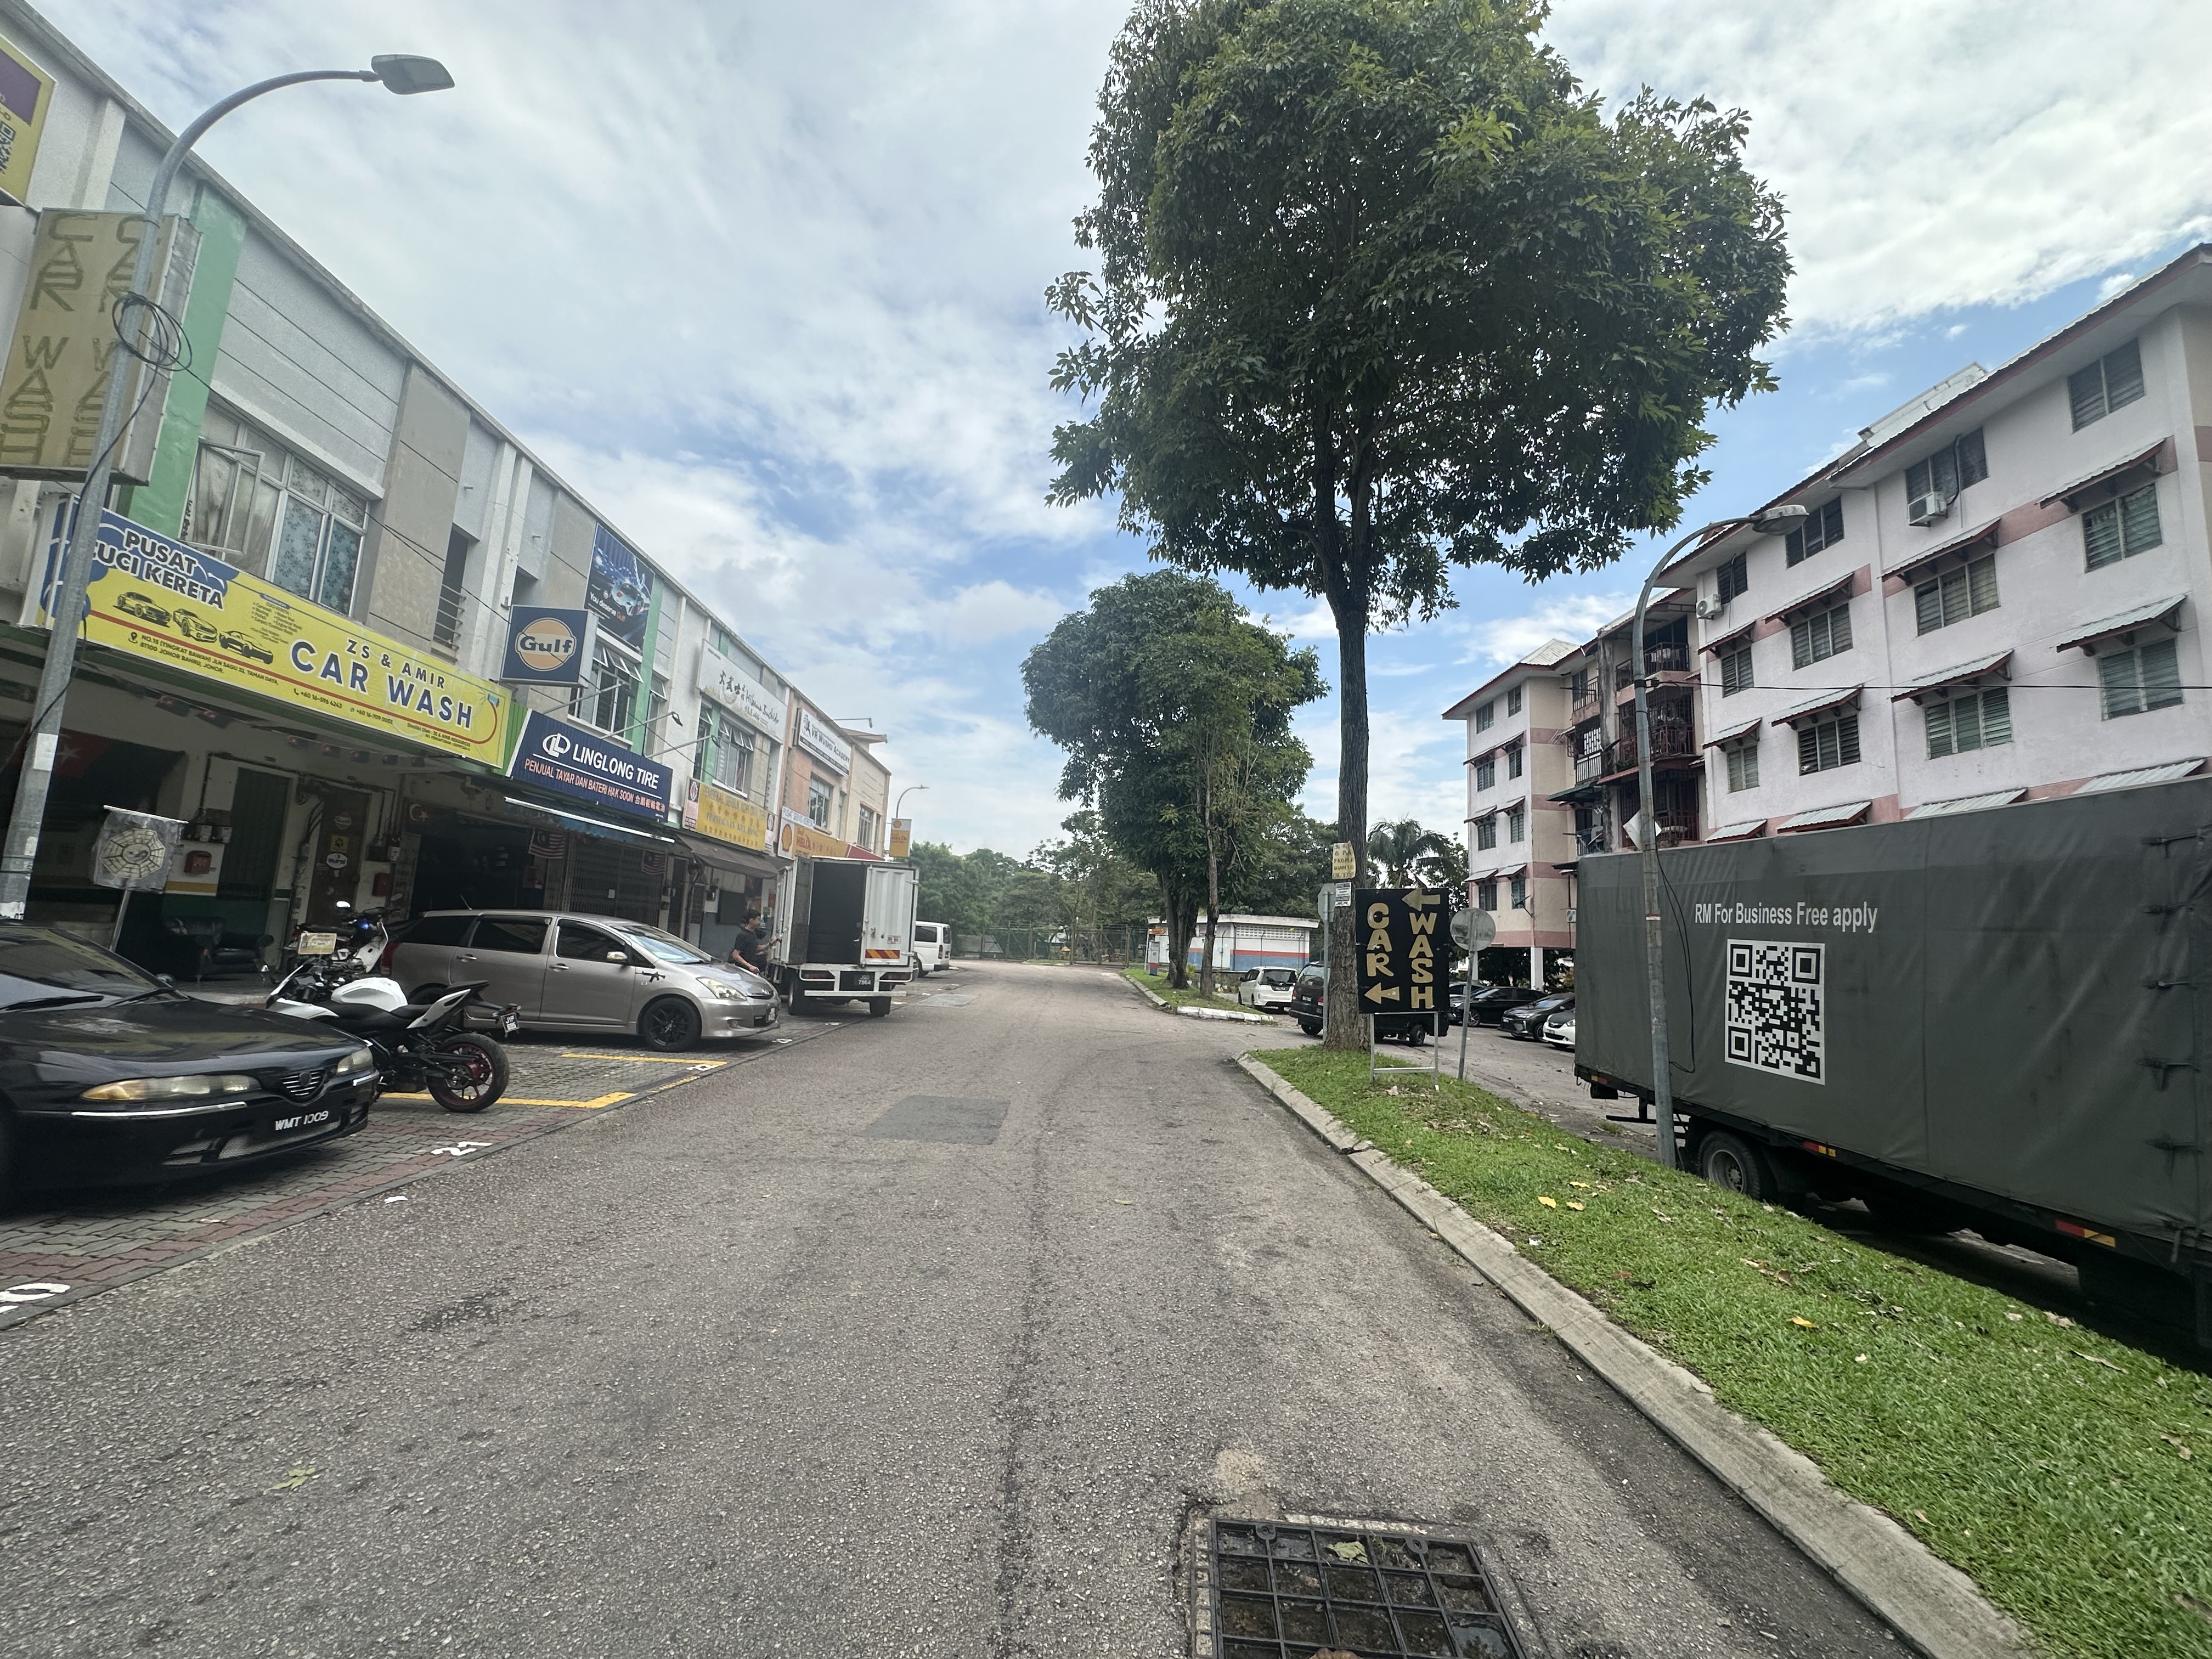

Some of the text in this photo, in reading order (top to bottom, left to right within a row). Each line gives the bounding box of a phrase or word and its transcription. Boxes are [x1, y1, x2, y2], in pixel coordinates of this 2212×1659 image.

[29, 213, 98, 312] CAR
[125, 529, 198, 574] PUSAT
[93, 541, 223, 610] UCI KERETA
[590, 591, 599, 603] You
[159, 648, 180, 659] JOHOR
[347, 639, 445, 689] ZS & AMIR
[520, 635, 573, 653] Gulf
[291, 641, 472, 729] CAR WASH
[524, 758, 634, 803] PENJUAL TAYAR DAN BATERI HAK SOON
[572, 744, 659, 789] LINGLONG TIRE
[1695, 901, 1878, 933] RM For Business Free apply
[1366, 902, 1437, 1009] CAR WASH
[275, 1110, 329, 1131] WMT 1009
